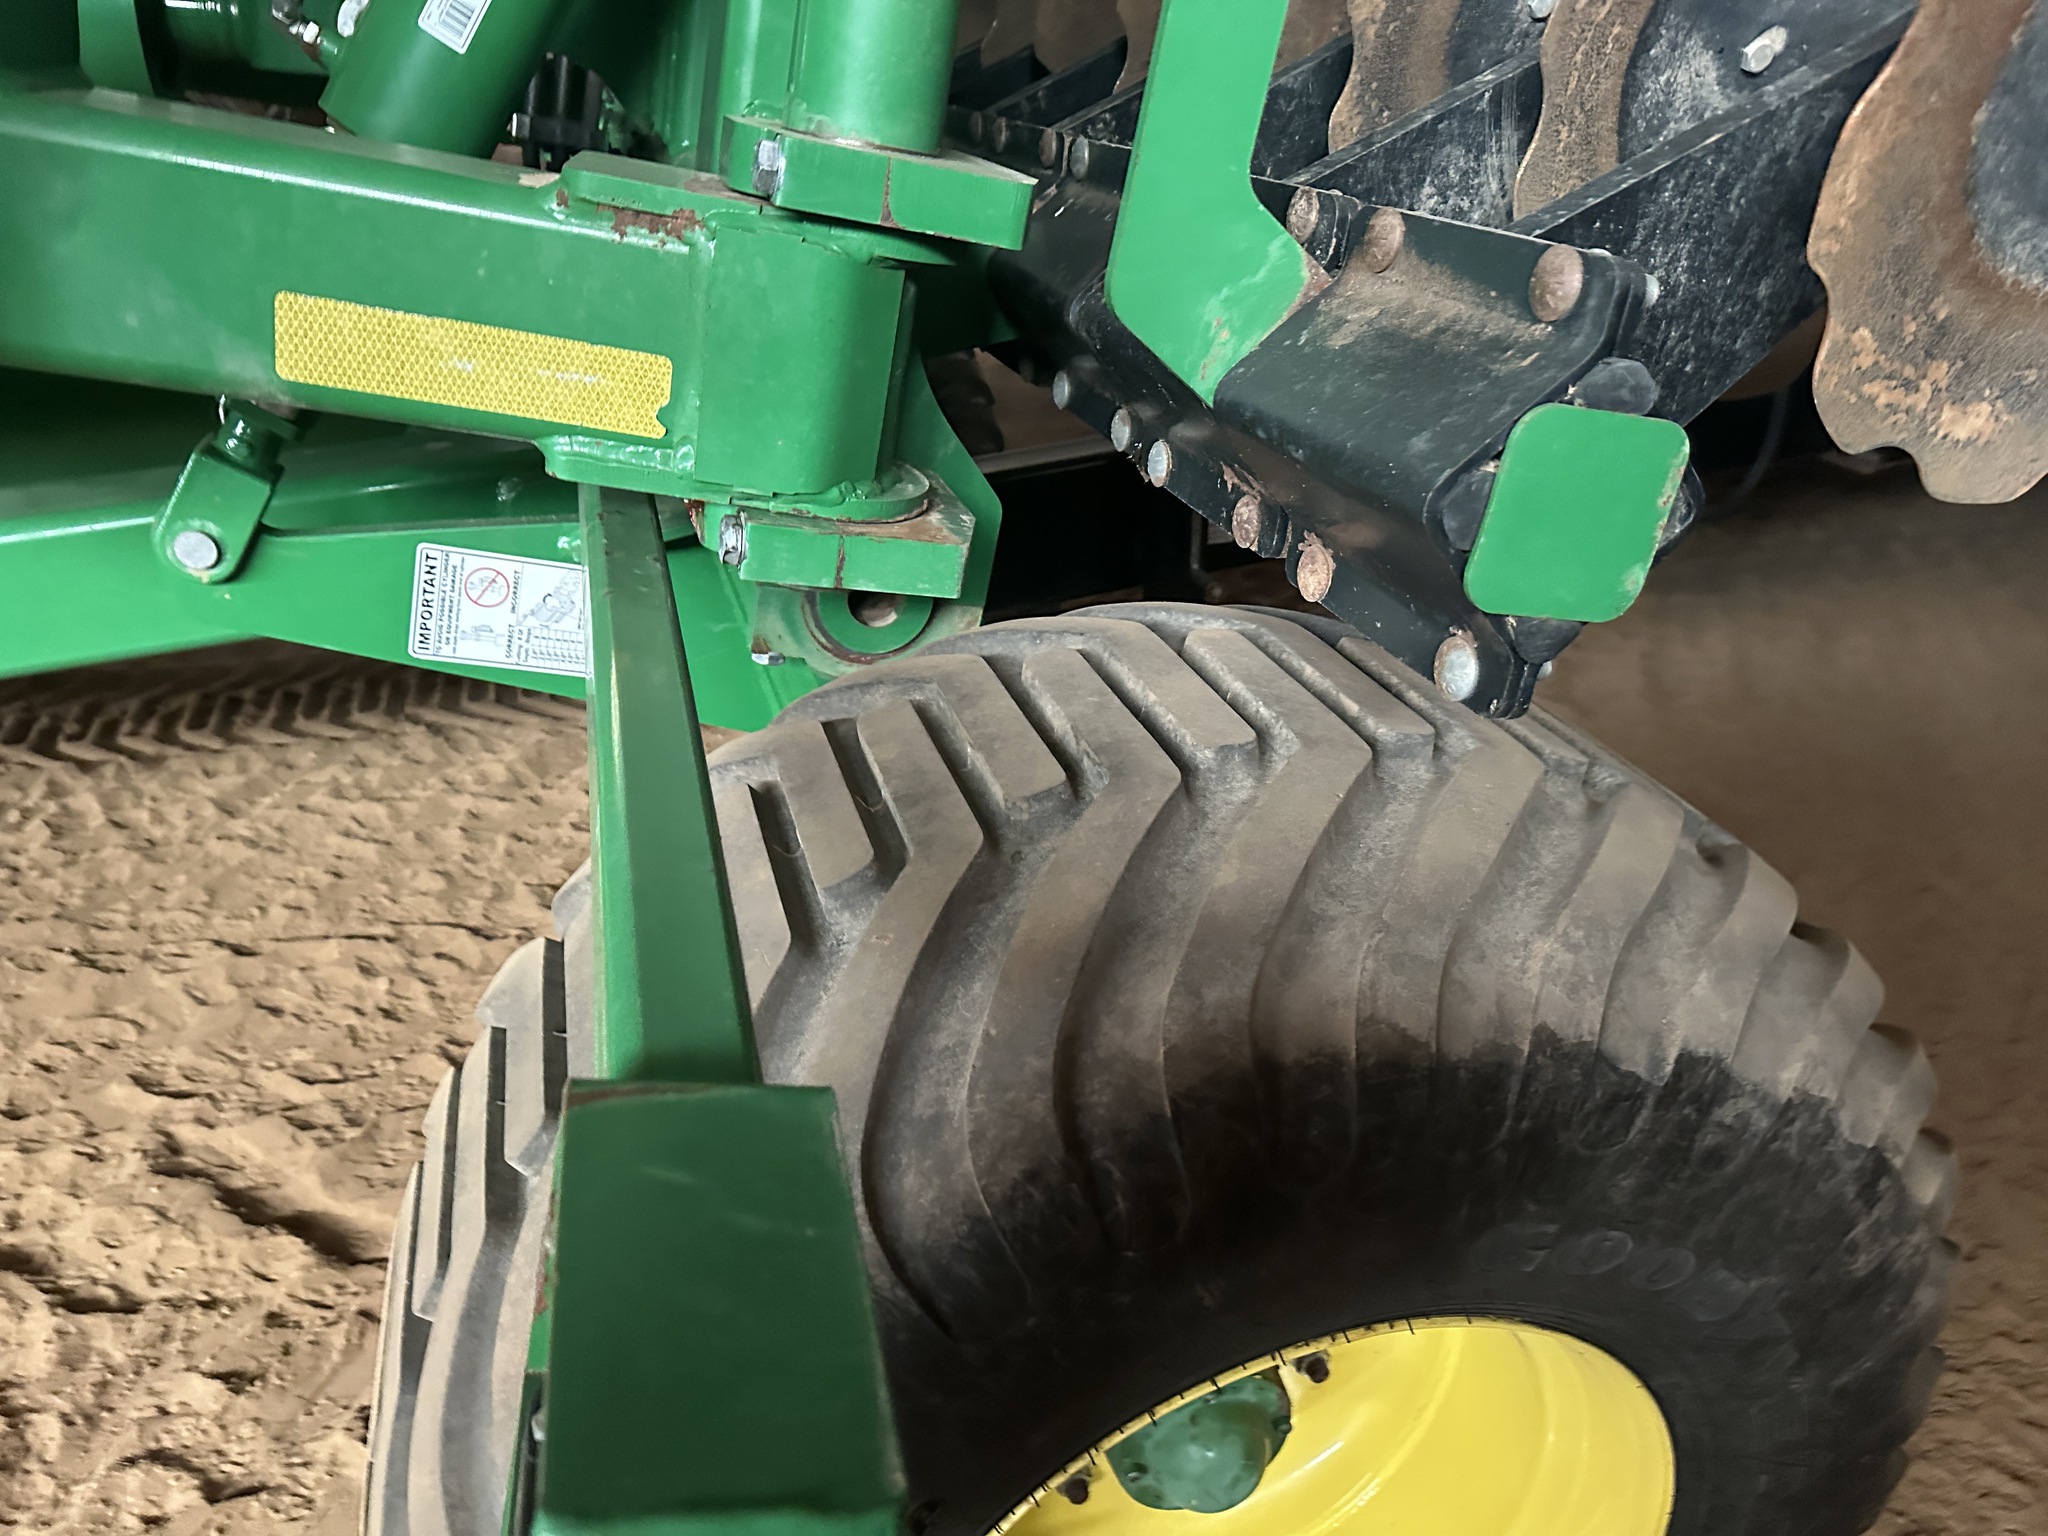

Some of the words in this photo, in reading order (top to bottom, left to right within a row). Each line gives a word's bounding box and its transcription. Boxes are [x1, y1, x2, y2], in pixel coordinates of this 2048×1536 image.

[418, 552, 438, 650] IMPORTANT
[505, 624, 515, 658] CORRECT
[510, 570, 520, 613] INCORRECT
